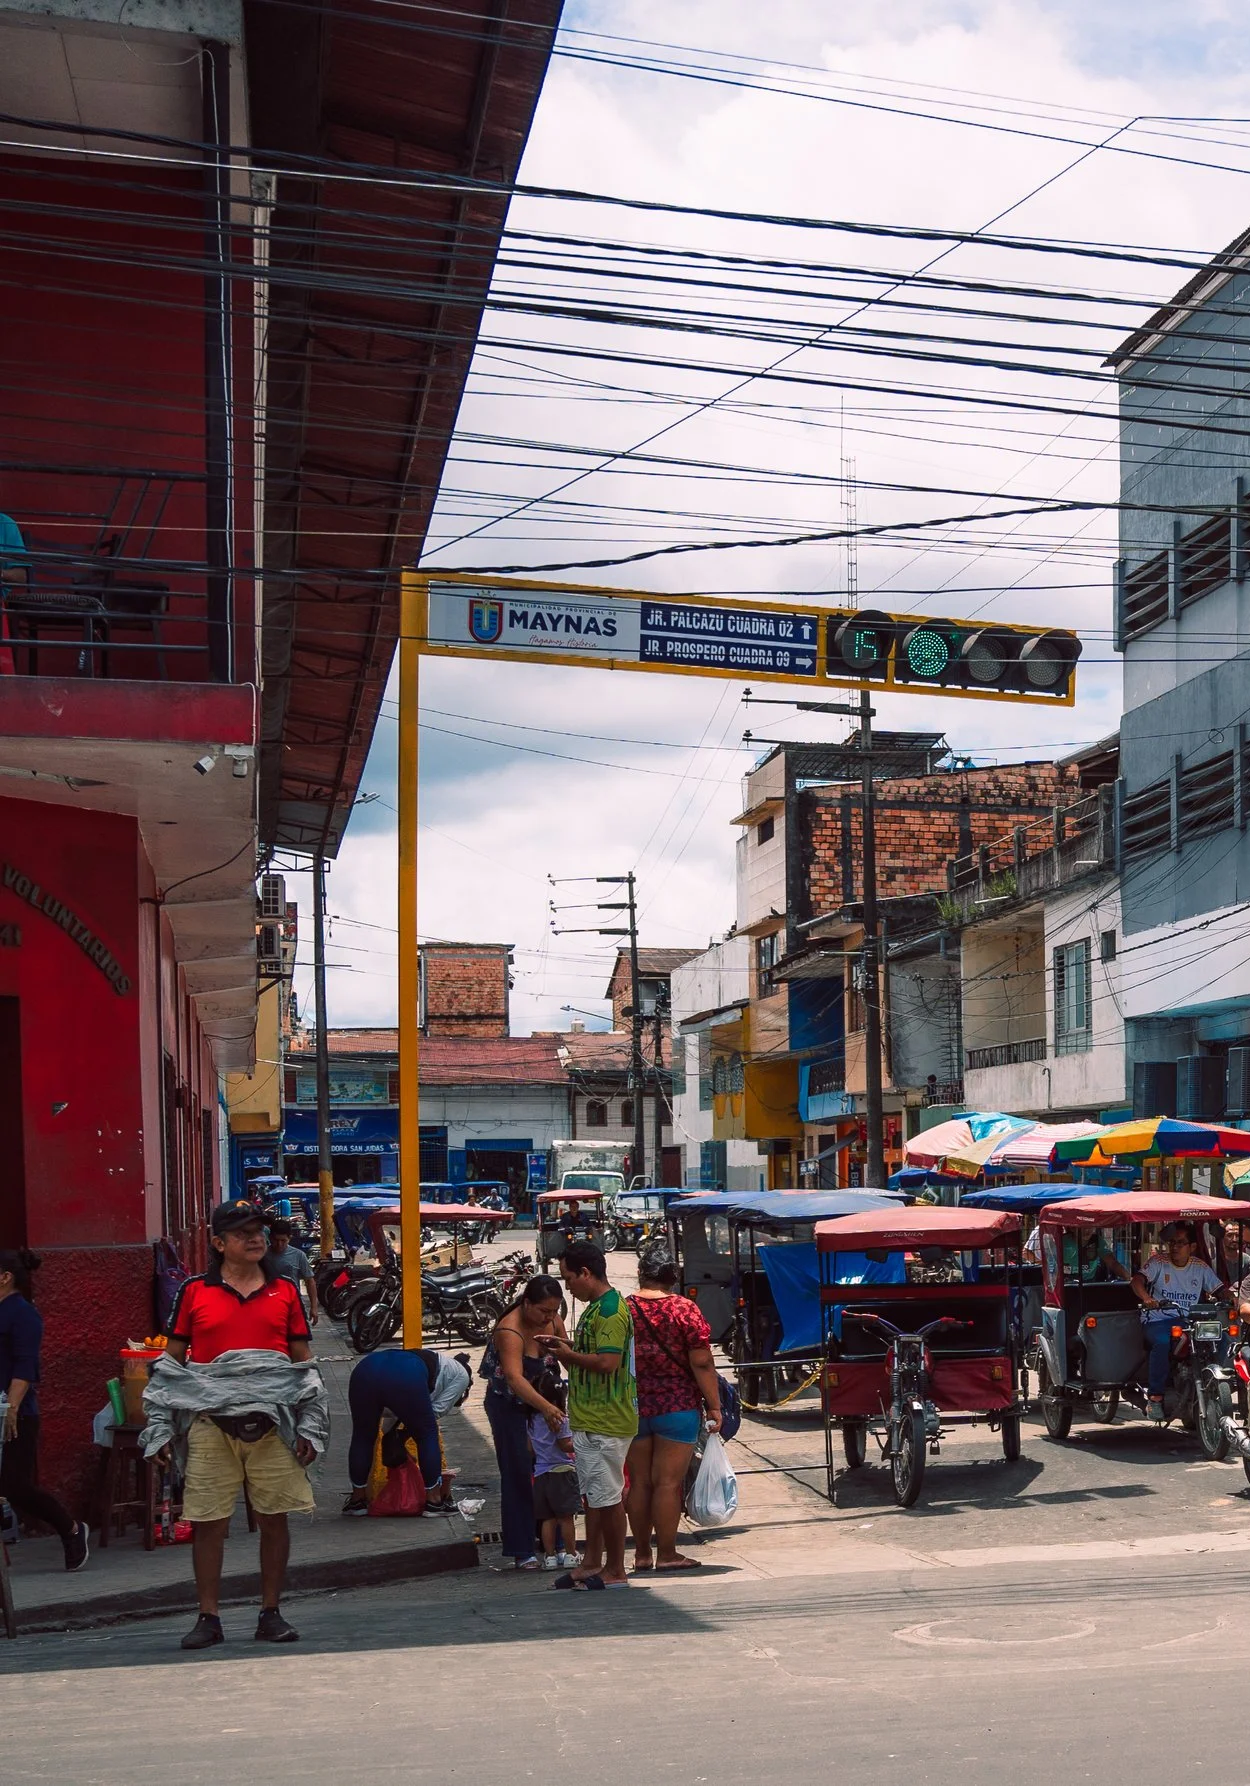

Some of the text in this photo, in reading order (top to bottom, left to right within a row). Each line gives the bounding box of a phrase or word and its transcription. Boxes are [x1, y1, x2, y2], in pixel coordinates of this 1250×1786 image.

[509, 609, 618, 637] MAYNAS
[647, 609, 794, 638] JR. PALCAZU CUADRA 02
[645, 640, 790, 667] JR. PROSPERO CUADRA 09
[855, 630, 877, 660] 15
[3, 863, 131, 996] VOLUNTARIOS
[350, 1144, 363, 1152] SAN
[364, 1144, 384, 1152] JUDAS
[1161, 1289, 1198, 1301] Emirates
